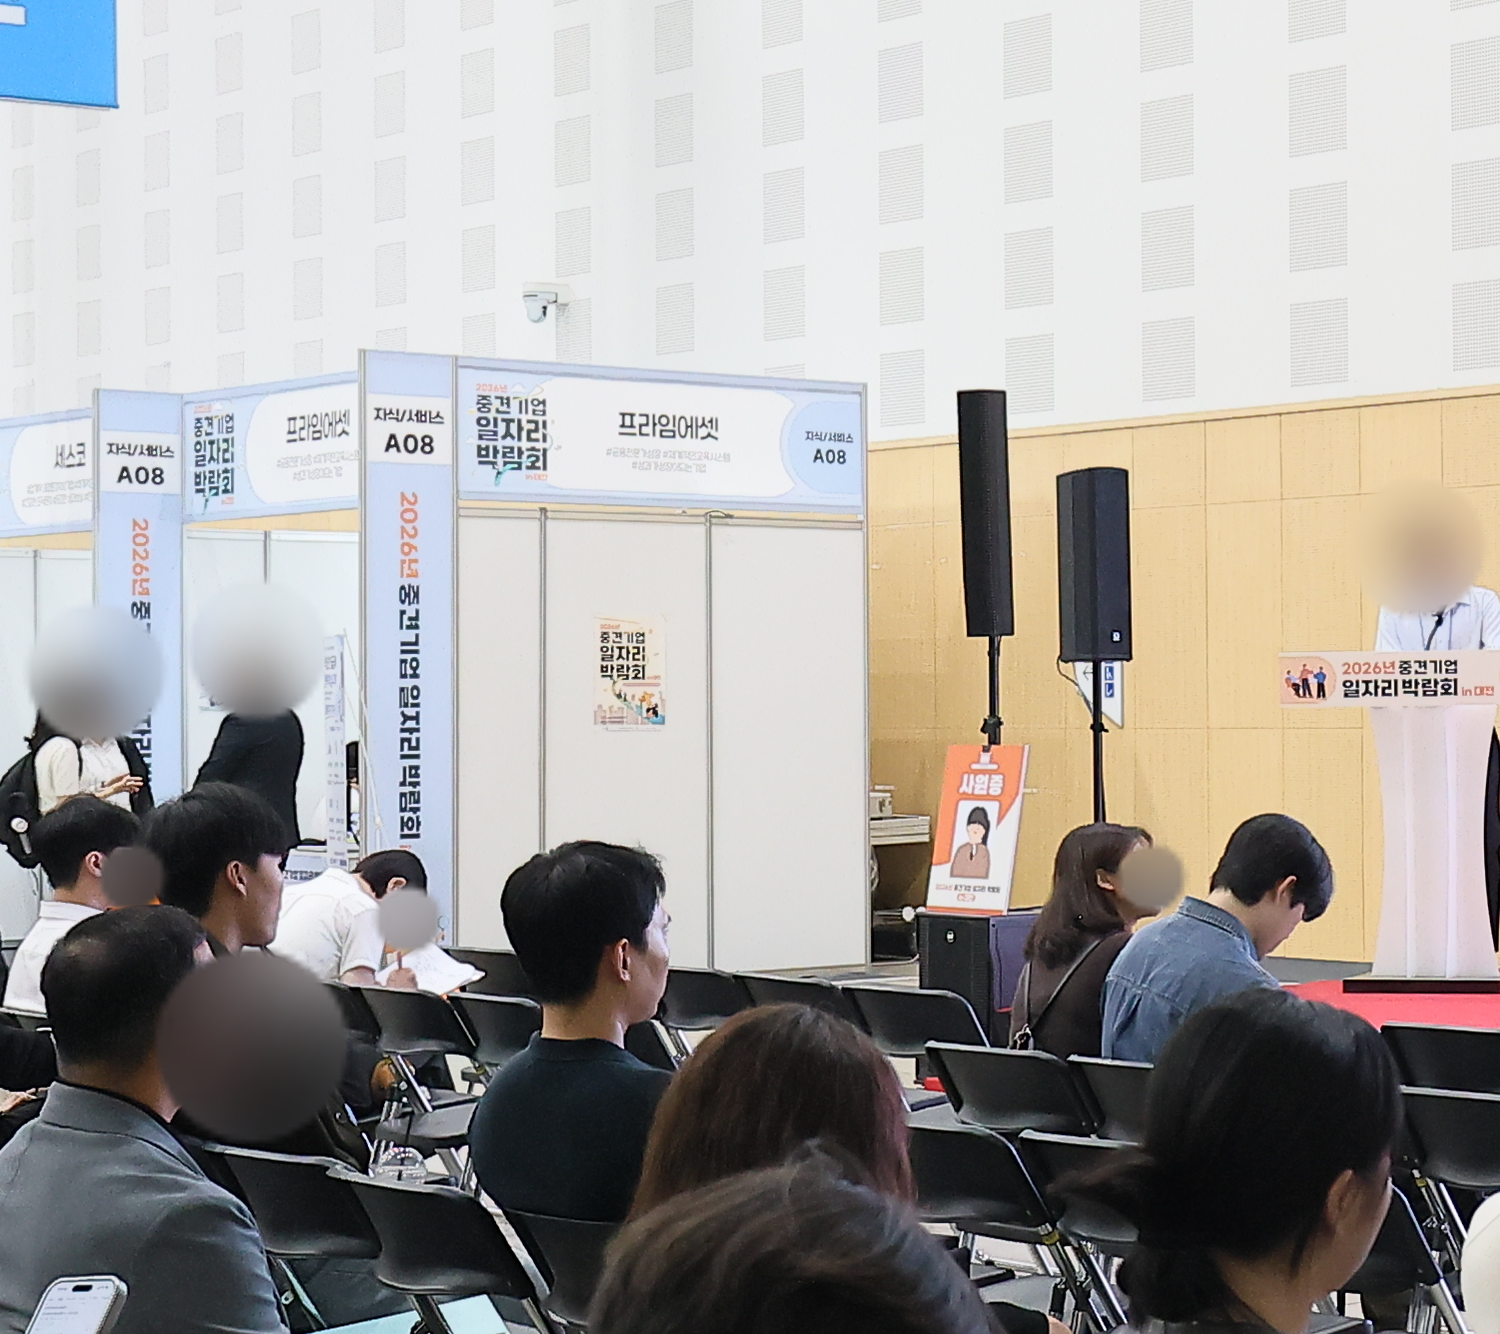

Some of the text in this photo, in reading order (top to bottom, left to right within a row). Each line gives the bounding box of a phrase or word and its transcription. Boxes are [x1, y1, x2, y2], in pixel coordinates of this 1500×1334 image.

[374, 407, 445, 425] 지식/서비스
[475, 393, 547, 416] 중견기업
[286, 408, 350, 443] 프라임에셋
[476, 416, 548, 443] 일자리
[618, 411, 719, 442] 프라임에셋
[55, 442, 86, 469] 세스코
[194, 436, 234, 467] 일자리
[384, 433, 434, 455] A08
[476, 444, 548, 472] 박람회
[812, 448, 847, 465] A08
[116, 466, 164, 485] A08
[194, 467, 234, 497] 박람회
[131, 518, 150, 596] 2026년
[600, 631, 645, 644] 중견기업
[600, 645, 646, 662] 일자리
[398, 491, 421, 840] 2026년 중견기업 일자리 박람회
[600, 664, 646, 680] 박람회
[1342, 659, 1458, 675] 2026년 중견기업
[1342, 679, 1398, 698] 일자리
[1401, 678, 1458, 697] 박람회
[1462, 686, 1472, 696] in
[958, 773, 1005, 796] 사원증
